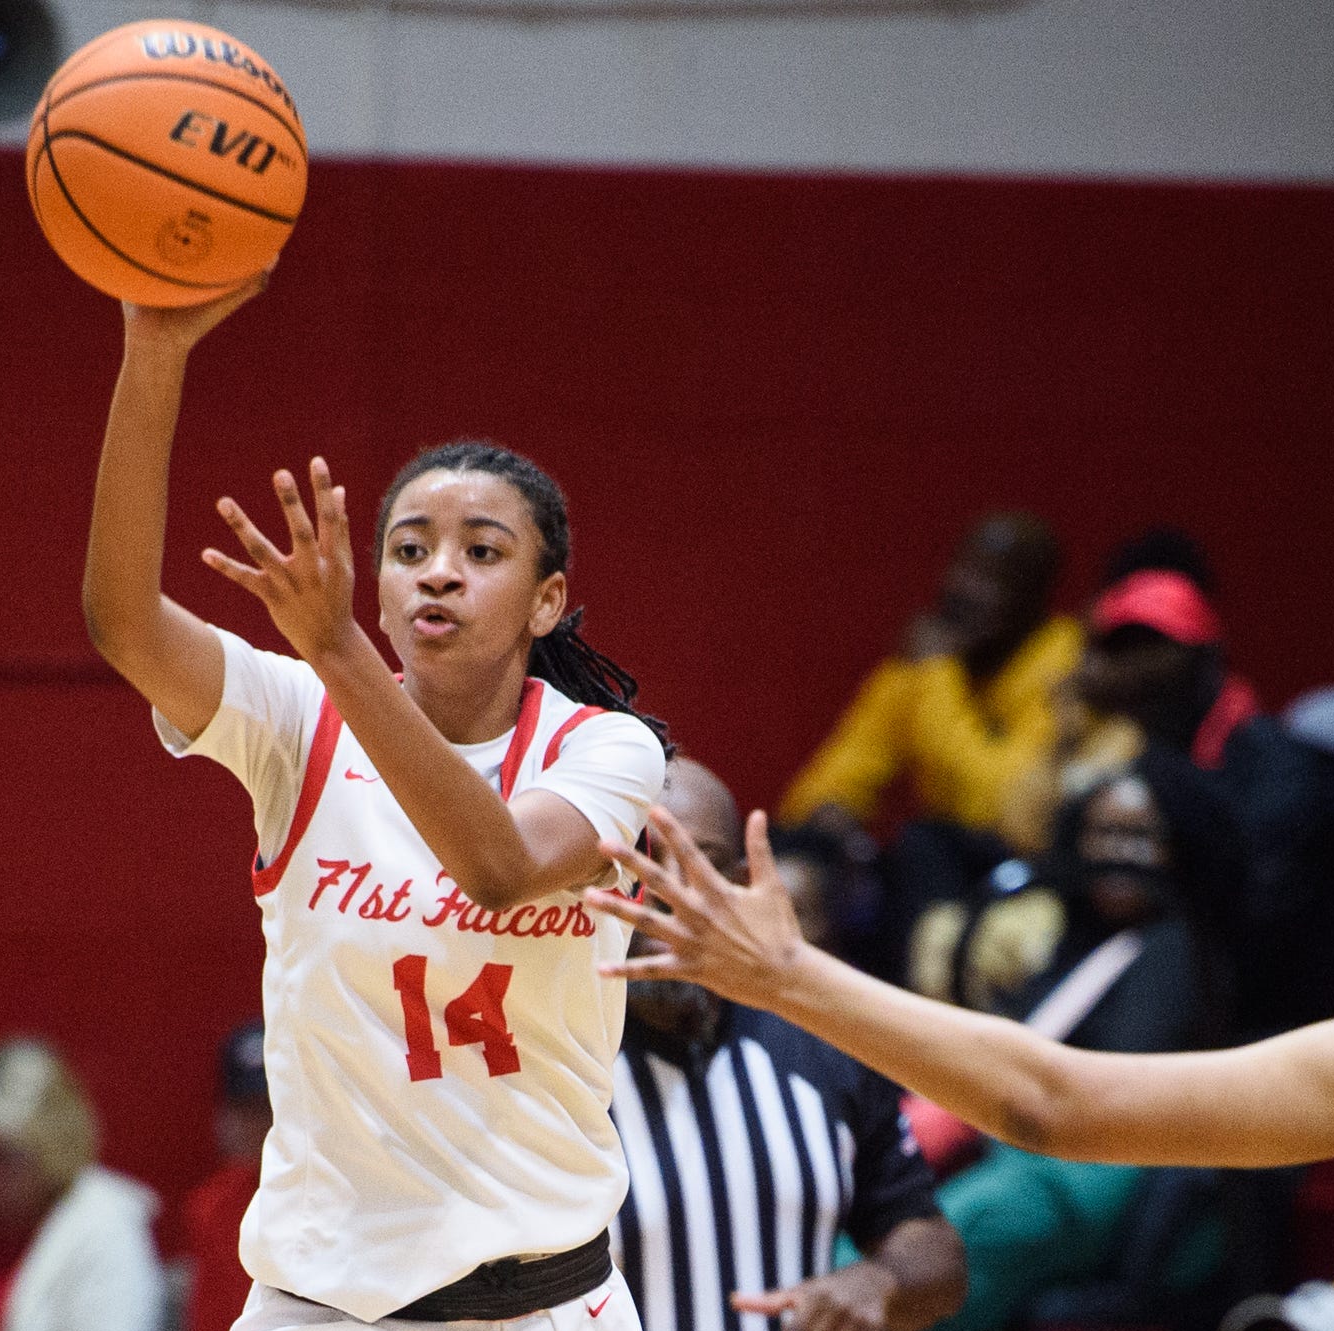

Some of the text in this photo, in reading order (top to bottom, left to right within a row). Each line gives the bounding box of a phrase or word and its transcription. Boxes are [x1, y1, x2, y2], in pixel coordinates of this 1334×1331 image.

[169, 109, 277, 175] EVO
[307, 858, 413, 922] 71st
[393, 954, 522, 1082] 14
